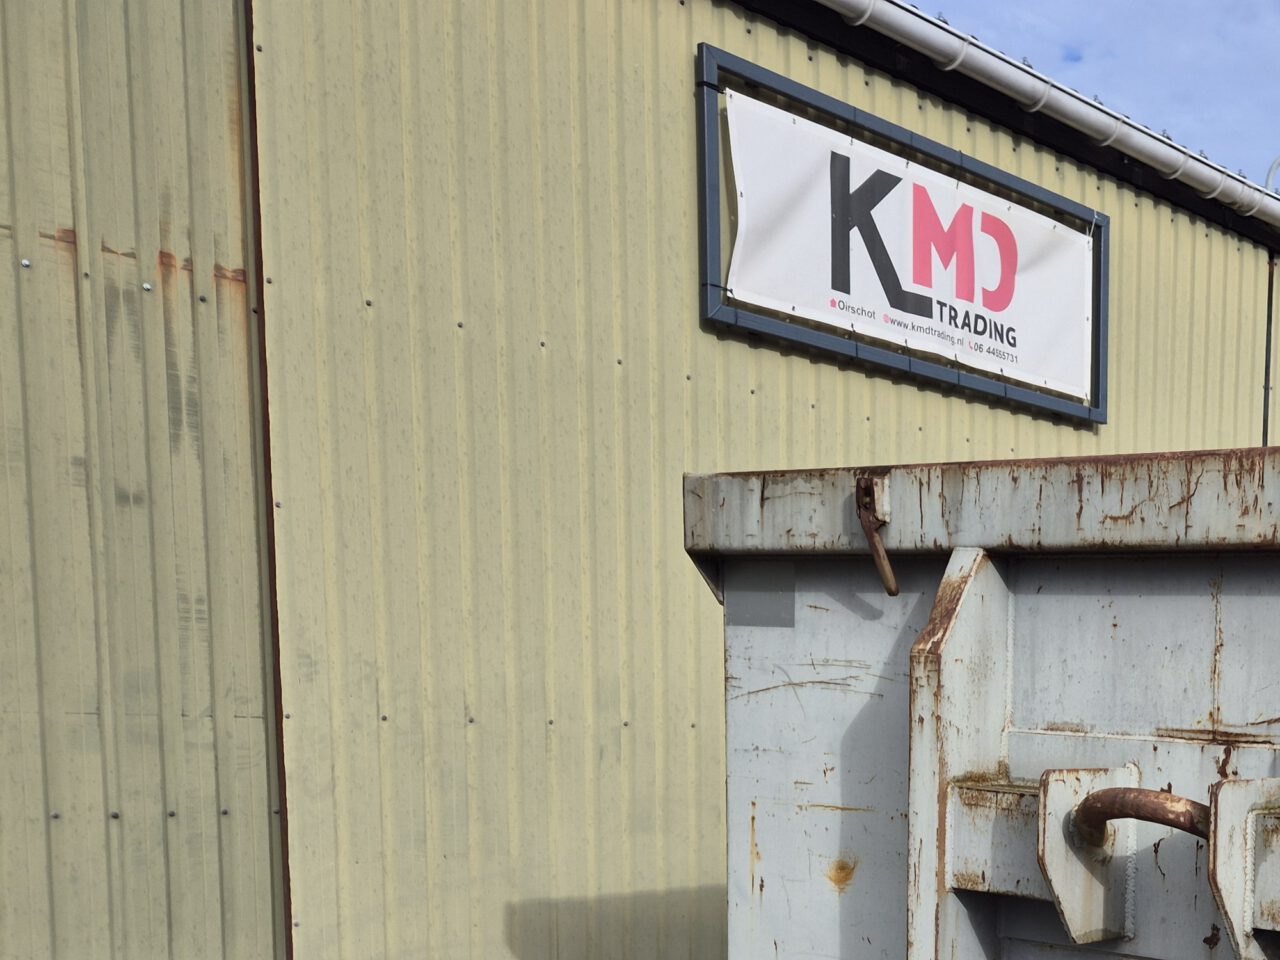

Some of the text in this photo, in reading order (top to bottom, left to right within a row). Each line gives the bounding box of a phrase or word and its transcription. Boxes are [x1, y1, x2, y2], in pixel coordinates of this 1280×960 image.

[830, 151, 1018, 318] KMD
[838, 299, 876, 320] Oirschot
[936, 299, 1017, 348] TRADING
[889, 317, 964, 346] www.kmdtrading.nl
[973, 342, 984, 353] 06
